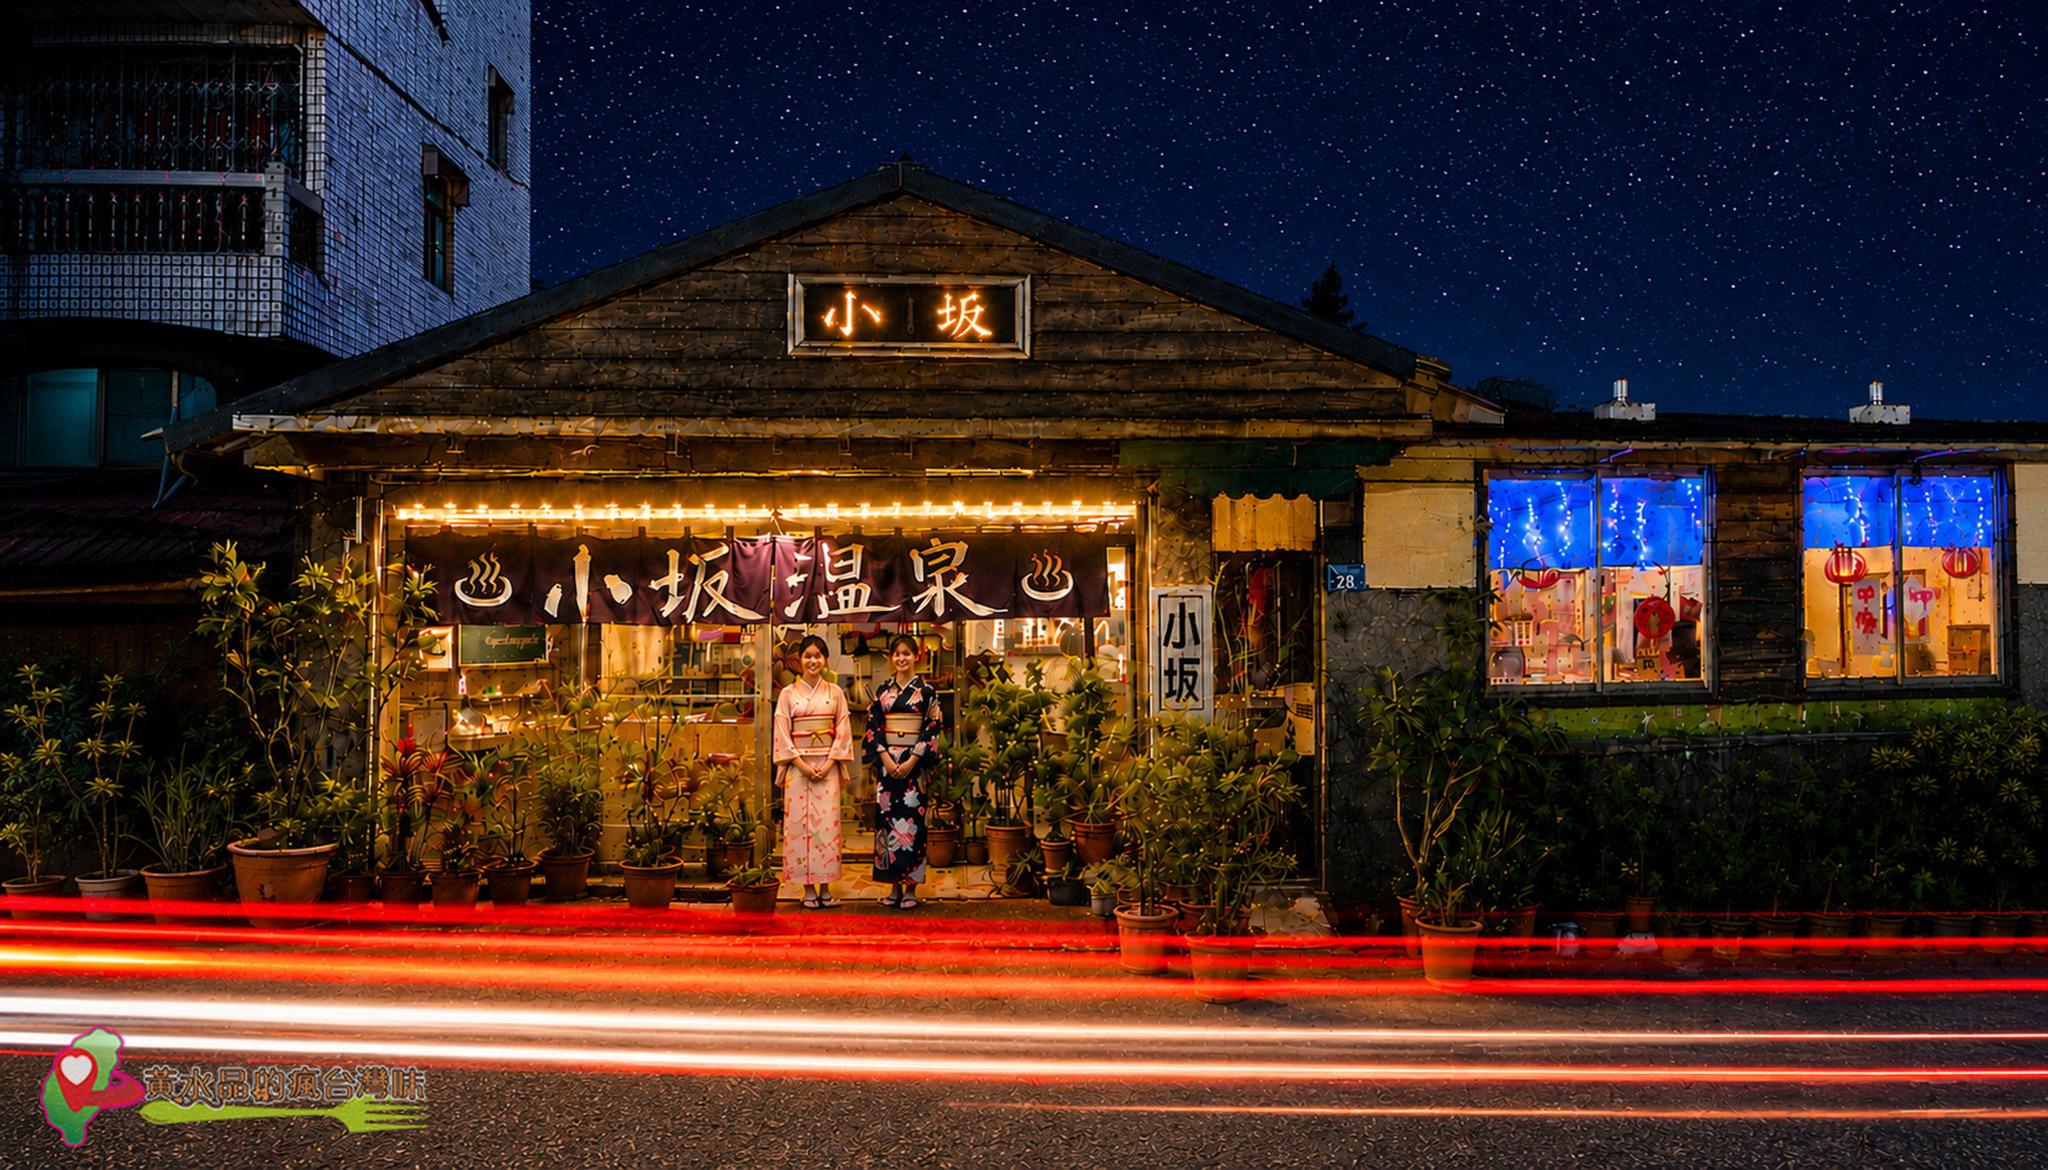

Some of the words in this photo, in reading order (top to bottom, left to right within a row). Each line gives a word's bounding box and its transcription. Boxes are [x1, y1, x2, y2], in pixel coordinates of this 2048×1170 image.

[822, 290, 993, 338] 小坂
[1336, 574, 1355, 589] 28
[1163, 602, 1201, 703] 小坂
